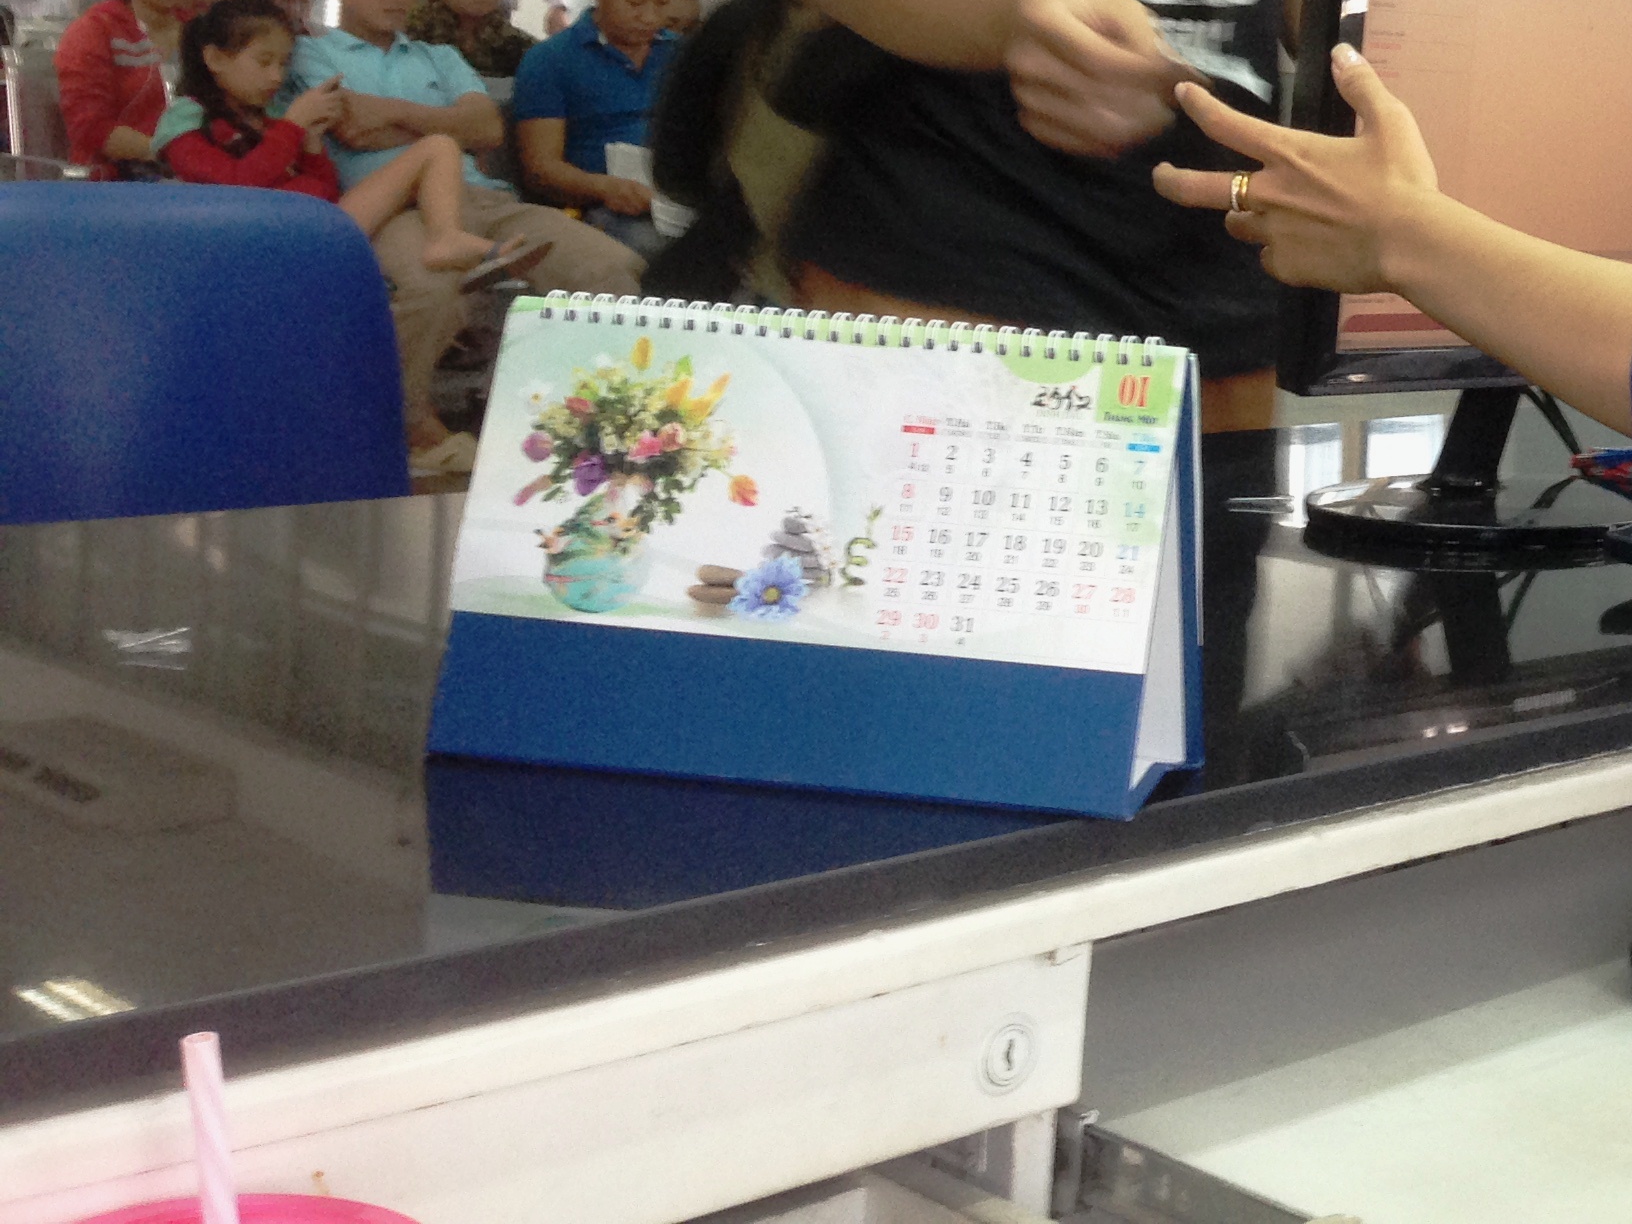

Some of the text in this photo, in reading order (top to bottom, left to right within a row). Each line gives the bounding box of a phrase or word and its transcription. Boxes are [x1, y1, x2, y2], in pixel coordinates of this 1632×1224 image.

[910, 442, 1146, 476] 1 2 3 4 5 6 7
[901, 483, 1146, 518] 8 9 10 11 12 13 14
[891, 525, 1140, 561] 15 16 17 18 19 20 21
[882, 567, 1136, 604] 22 23 24 25 26 27 28
[875, 609, 975, 633] 29 30 31
